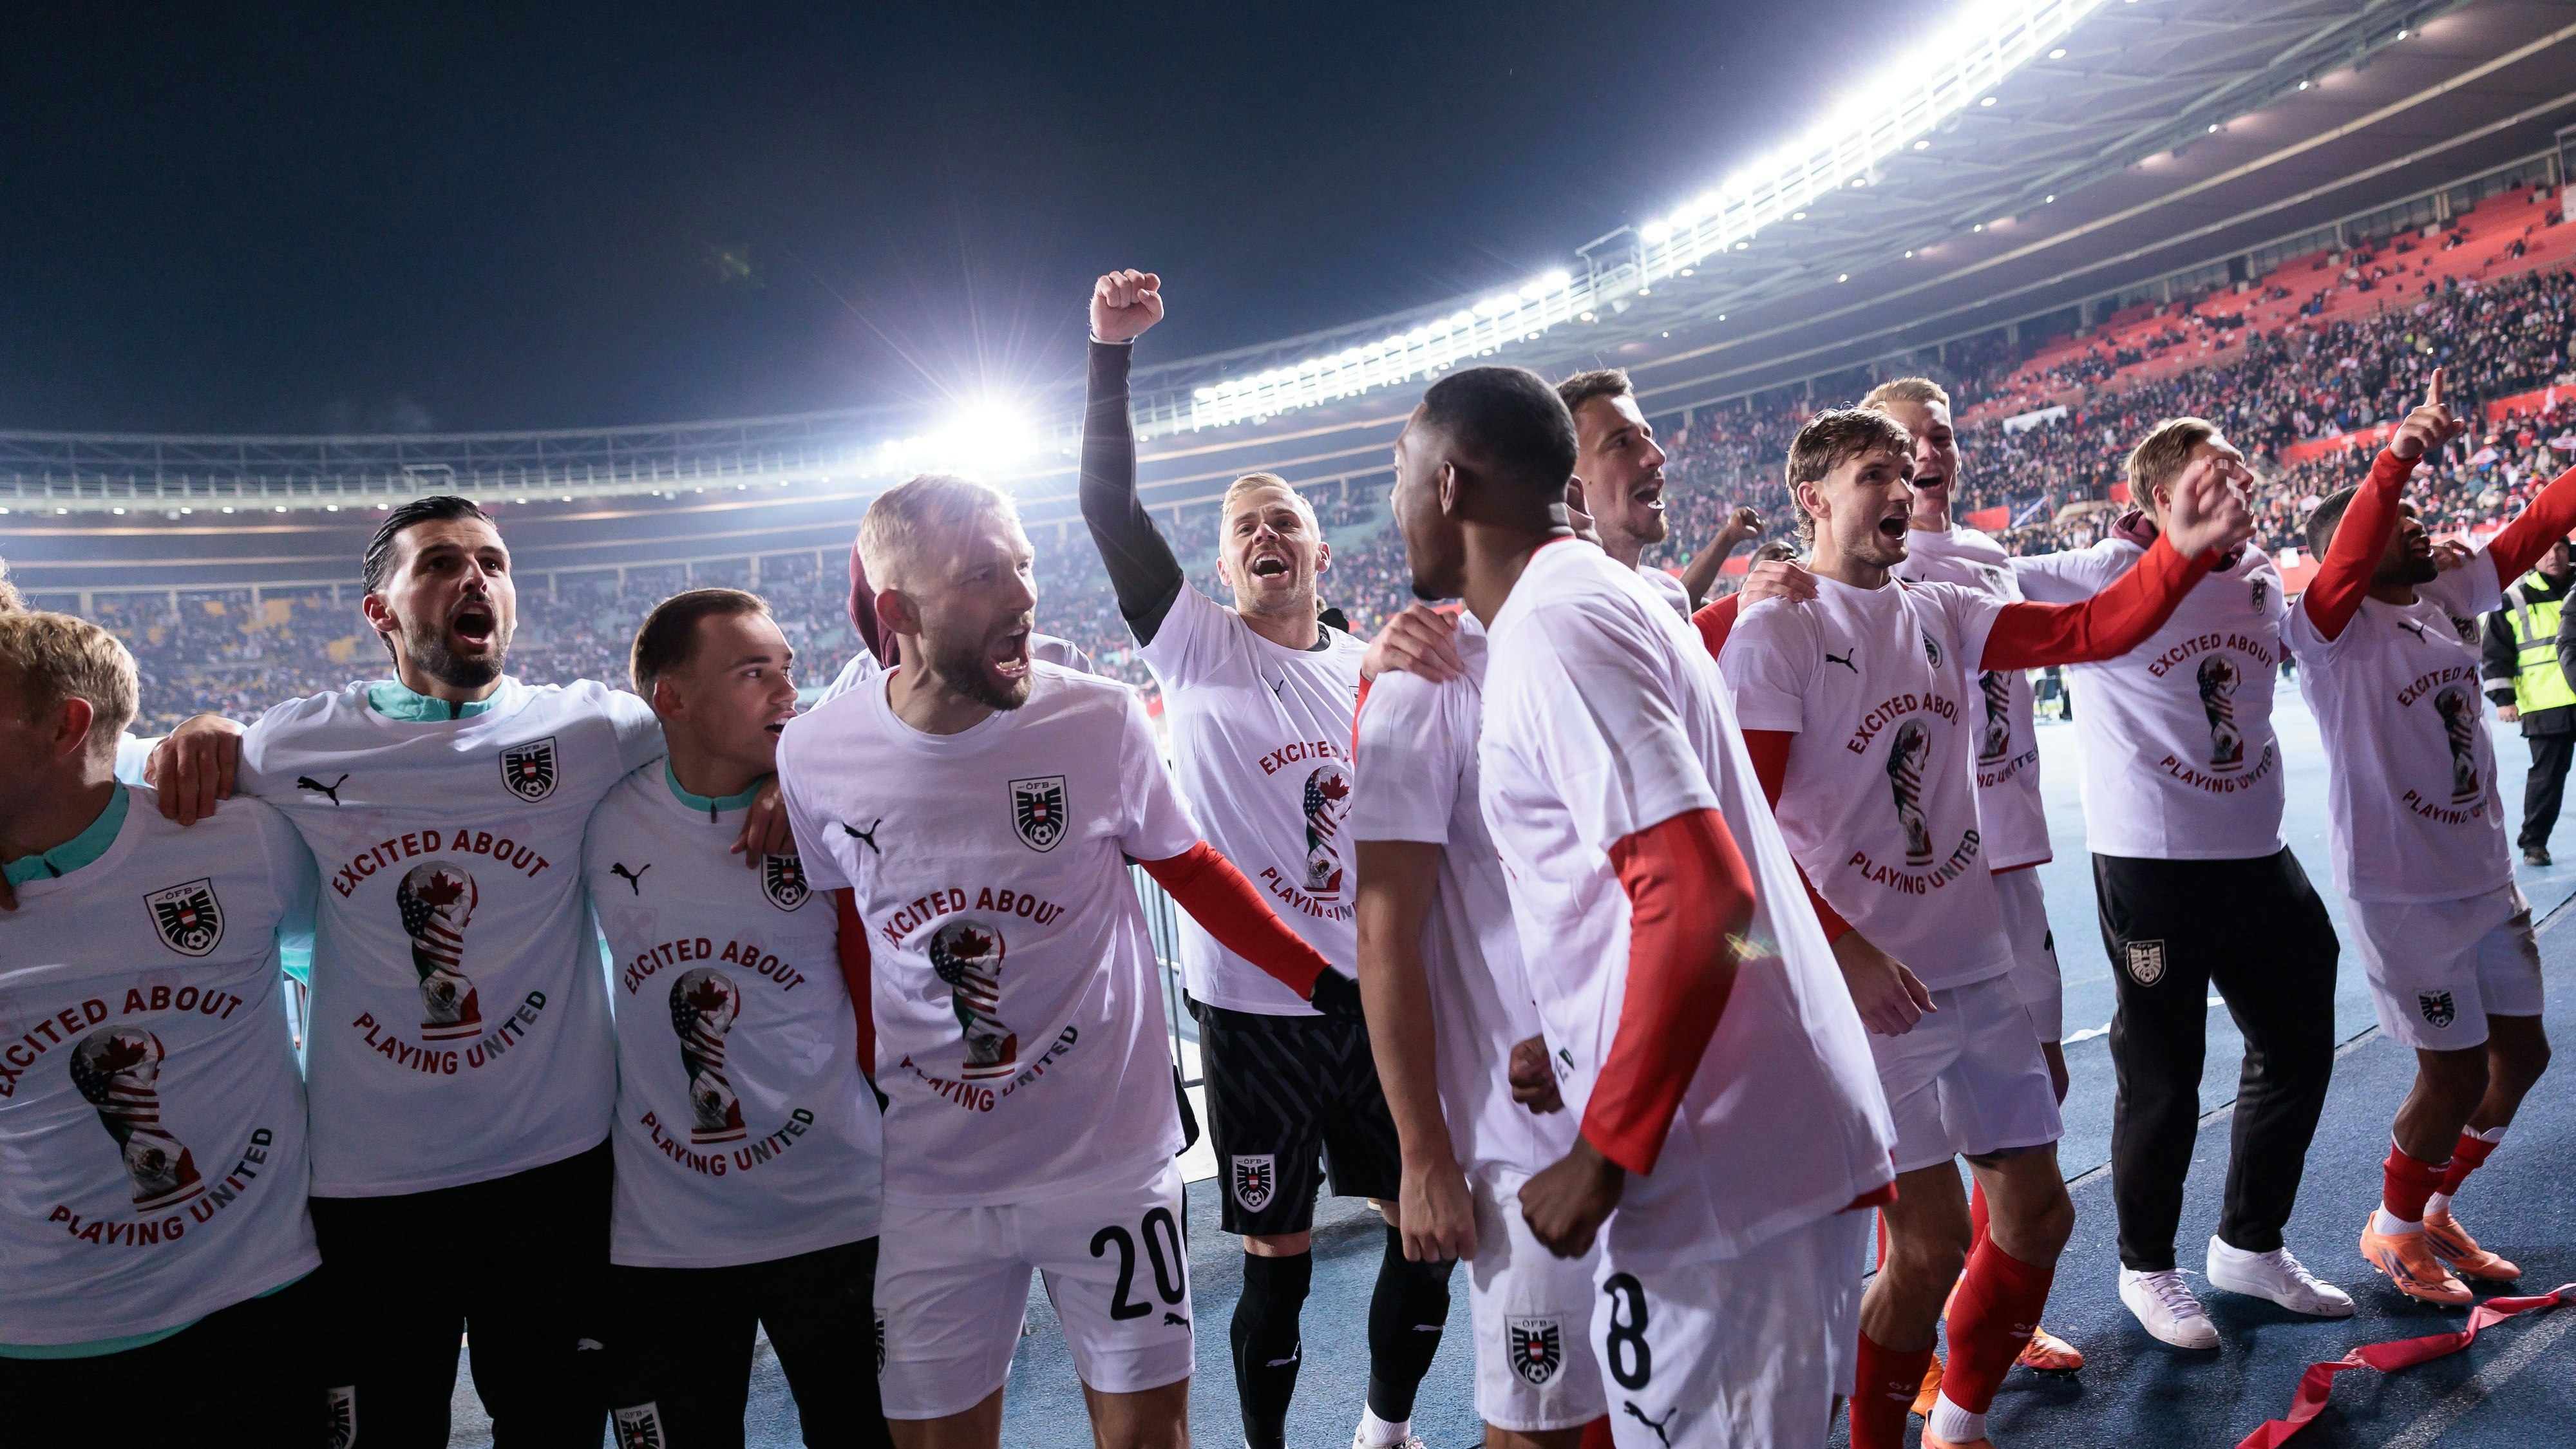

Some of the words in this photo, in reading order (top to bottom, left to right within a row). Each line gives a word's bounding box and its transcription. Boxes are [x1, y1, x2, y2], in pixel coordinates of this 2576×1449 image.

[2148, 634, 2221, 677] EXCITED
[2226, 634, 2274, 669] ABOUT
[2397, 667, 2461, 707] EXCITED
[1847, 693, 1917, 755] EXCITED
[1026, 779, 1049, 790] ÖFB
[2160, 755, 2234, 793] PLAYING
[332, 829, 442, 898] EXCITED
[451, 829, 550, 878] ABOUT
[1848, 851, 1926, 894] PLAYING
[1928, 829, 1980, 889] UNITED
[166, 887, 193, 900] ÖFB
[883, 888, 966, 951] XCITED
[976, 887, 1065, 925] ABOUT
[624, 938, 712, 995] EXCITED
[720, 940, 806, 991] ABOUT
[123, 986, 242, 1019] ABOUT
[353, 1012, 458, 1075] PLAYING
[466, 990, 547, 1068] UNITED
[641, 1111, 726, 1177] PLAYING
[737, 1108, 814, 1171] UNITED
[49, 1206, 184, 1245] PLAYING
[189, 1128, 273, 1224] UNITED
[1090, 1207, 1185, 1320] 20
[1604, 1273, 1651, 1390] 8
